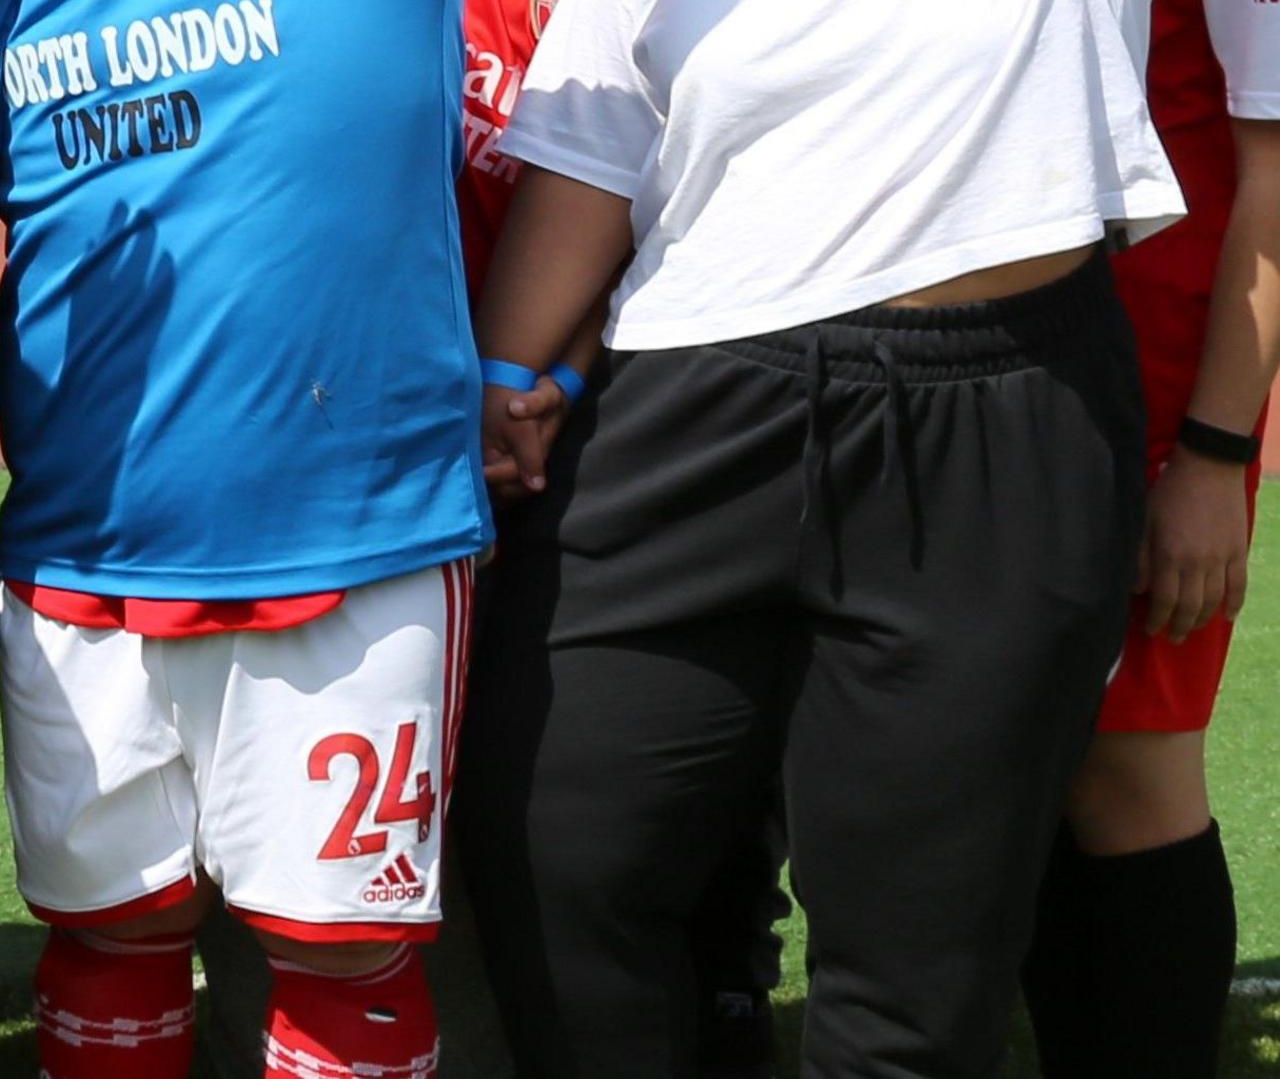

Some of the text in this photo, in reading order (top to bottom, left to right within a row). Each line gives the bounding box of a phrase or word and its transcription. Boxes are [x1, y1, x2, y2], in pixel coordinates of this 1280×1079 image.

[4, 31, 97, 108] ORTH
[52, 89, 202, 170] UNITED
[307, 721, 437, 861] 24
[363, 883, 426, 904] adidas
